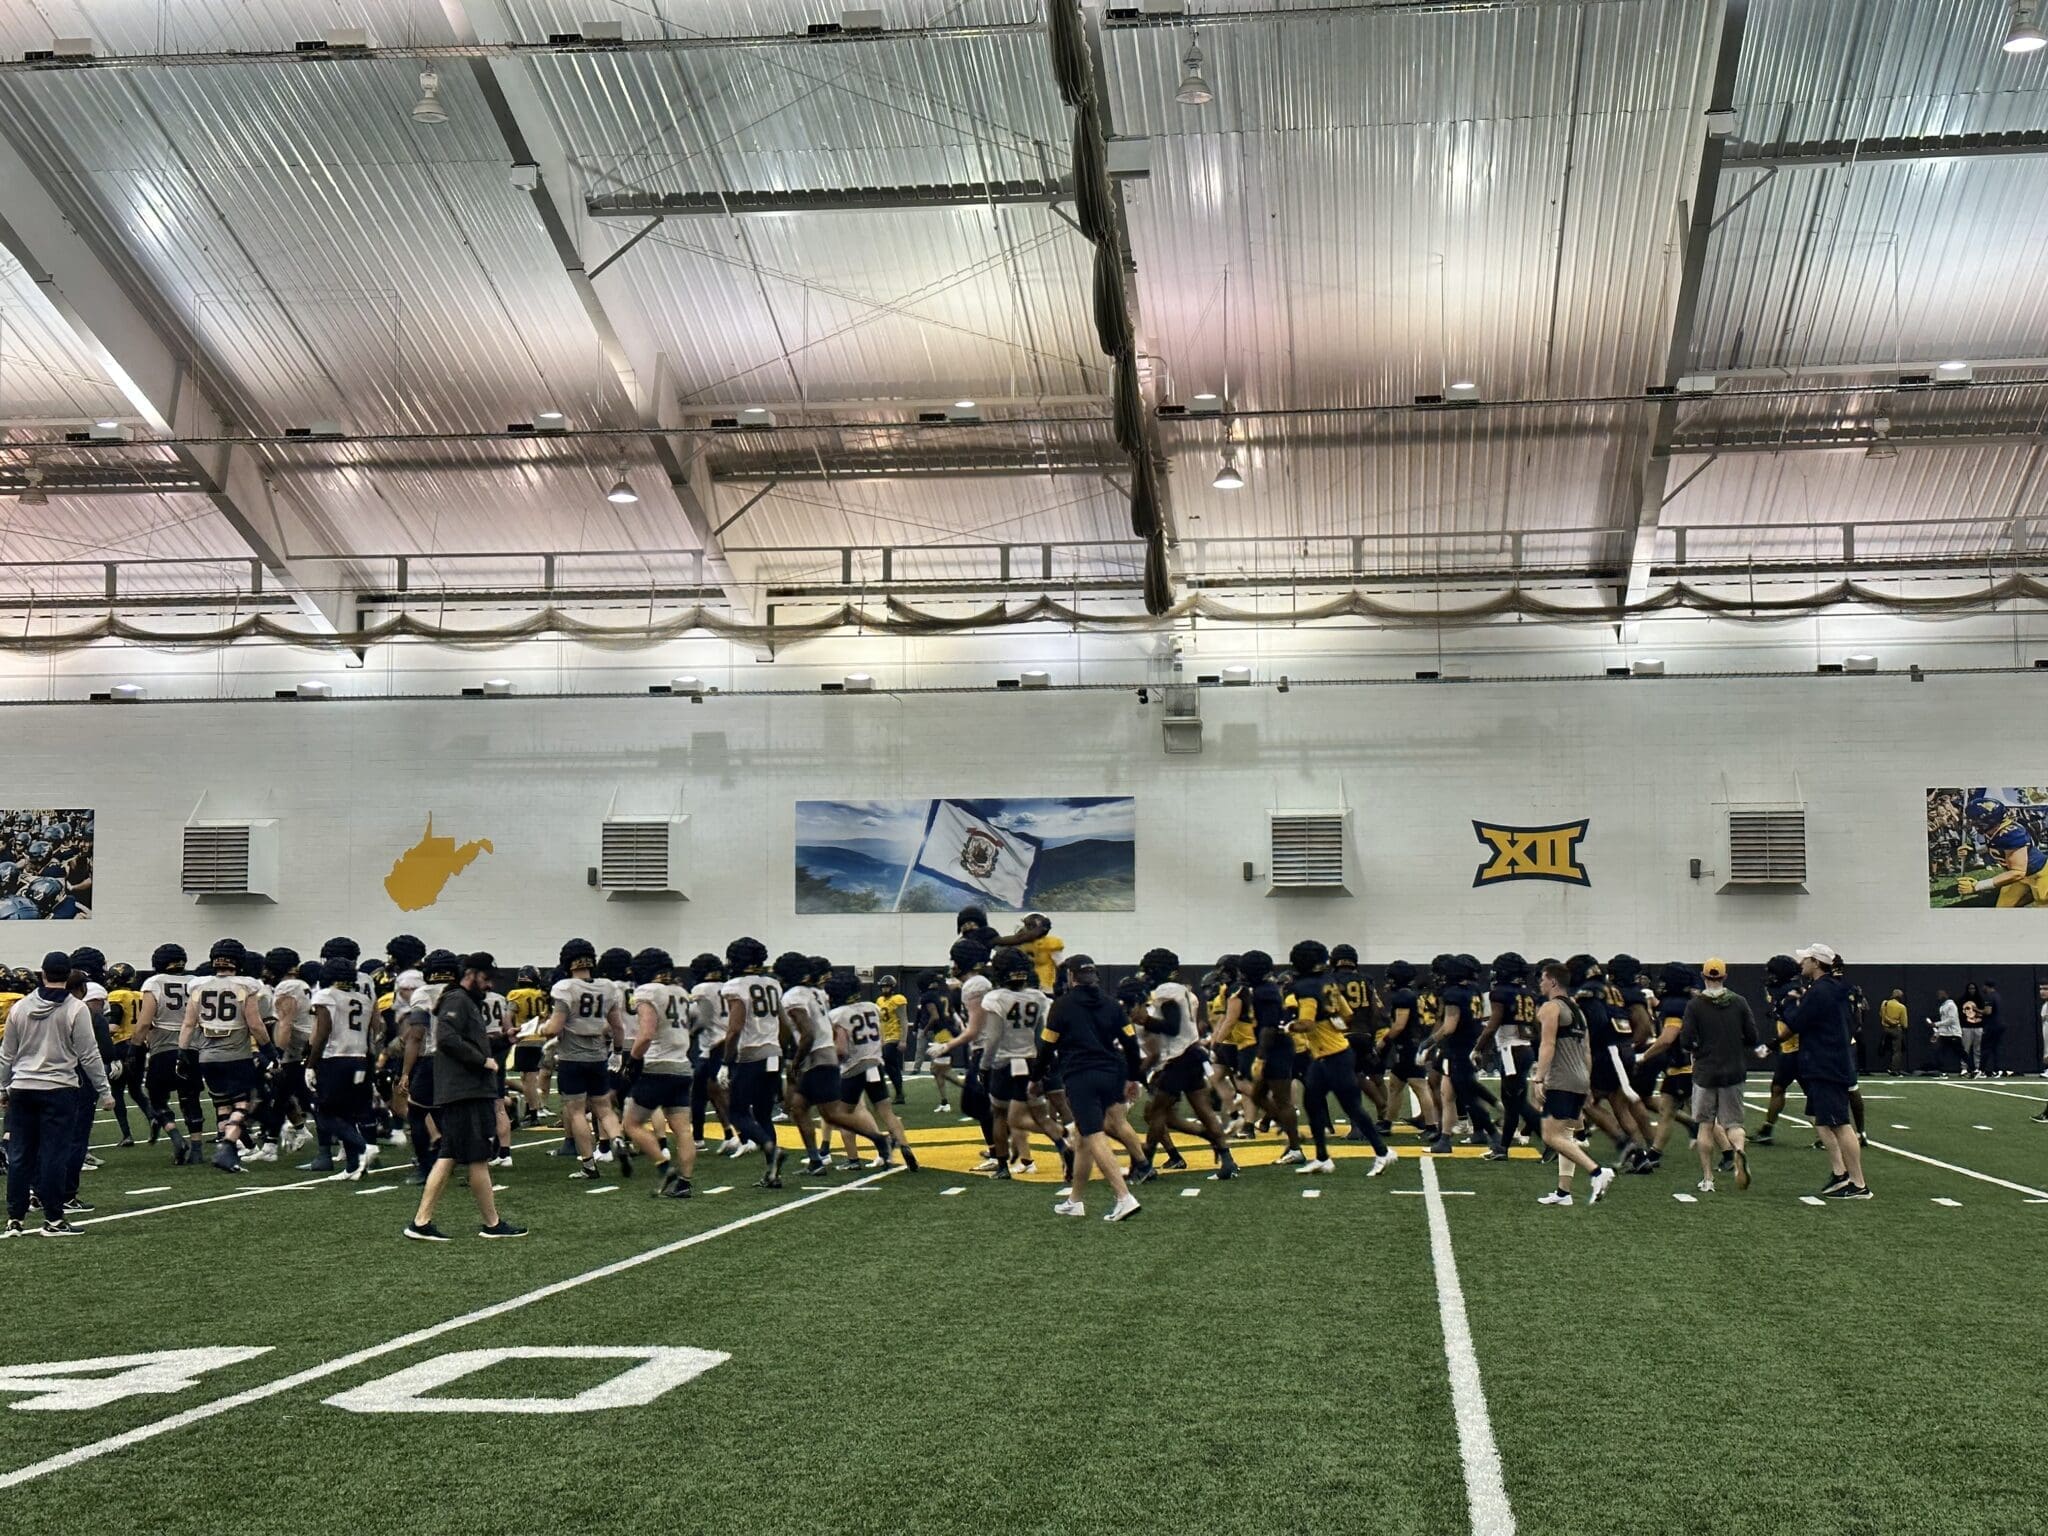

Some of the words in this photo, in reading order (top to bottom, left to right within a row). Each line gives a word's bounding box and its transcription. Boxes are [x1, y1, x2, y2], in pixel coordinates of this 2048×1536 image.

[1475, 821, 1588, 885] XII
[200, 991, 237, 1021] 56
[581, 993, 604, 1018] 81
[749, 984, 779, 1017] 80
[1347, 981, 1369, 1008] 91
[349, 999, 363, 1031] 2
[850, 1011, 880, 1045] 25
[1006, 1002, 1040, 1029] 49
